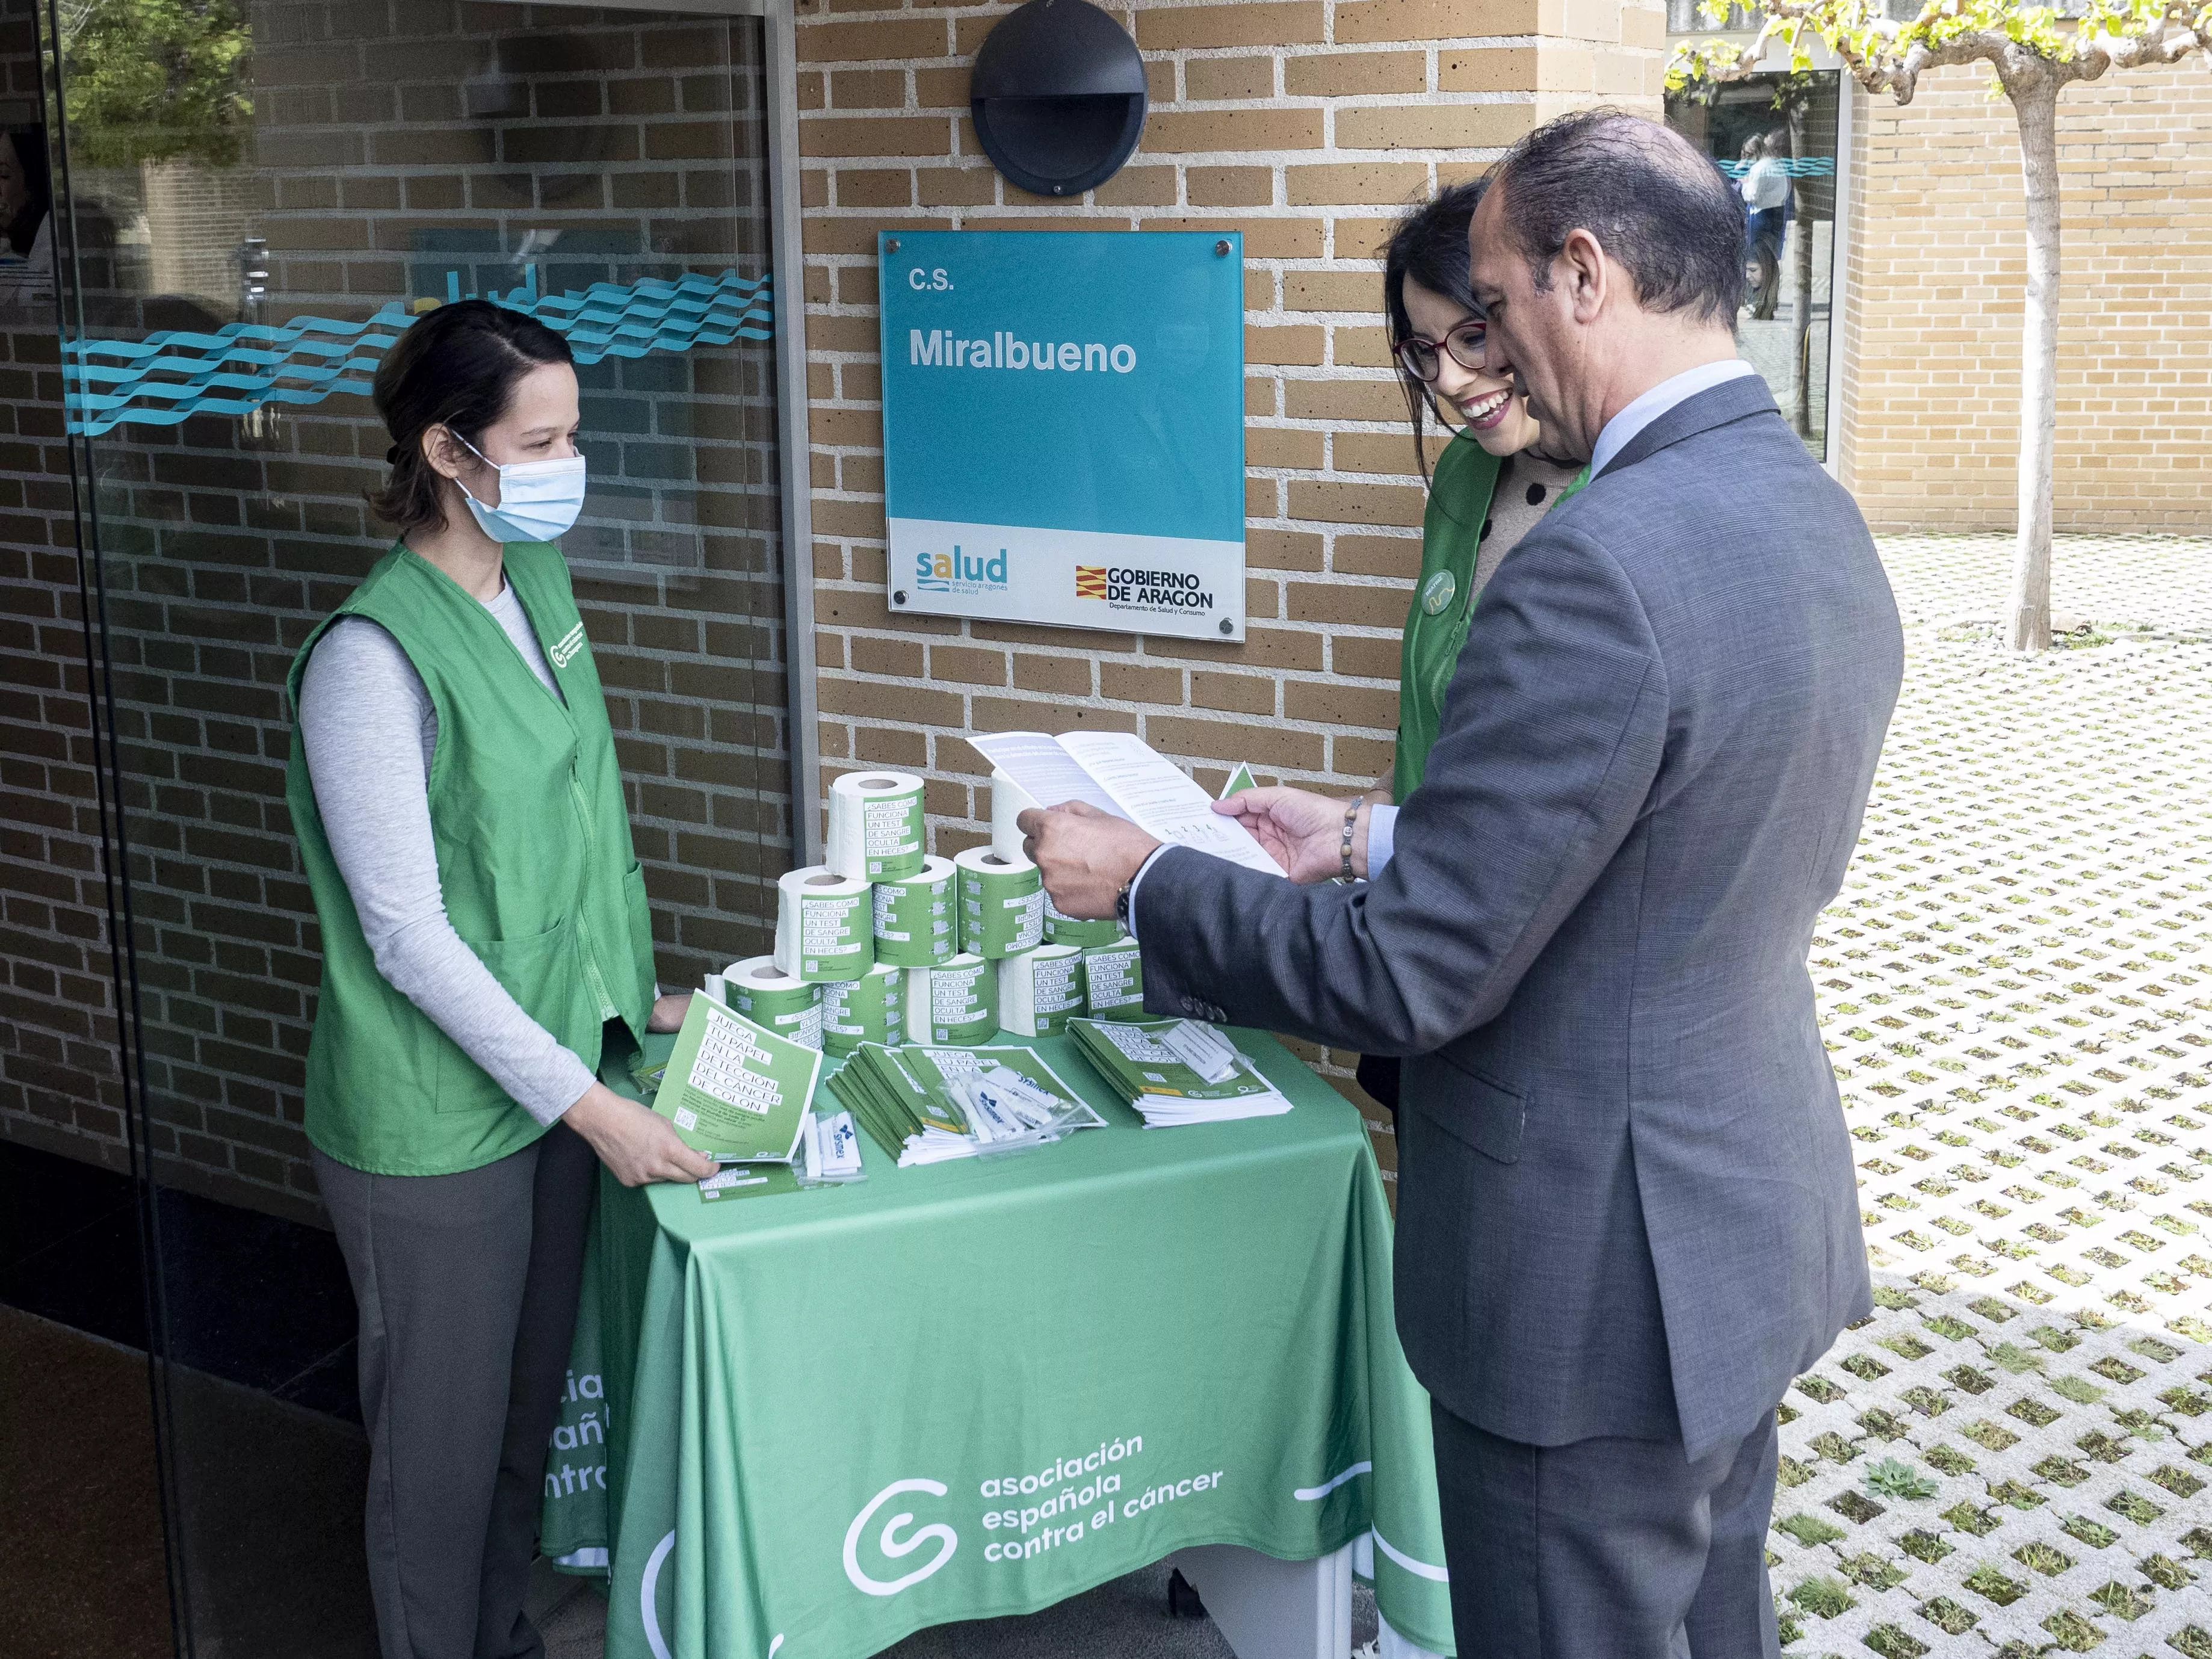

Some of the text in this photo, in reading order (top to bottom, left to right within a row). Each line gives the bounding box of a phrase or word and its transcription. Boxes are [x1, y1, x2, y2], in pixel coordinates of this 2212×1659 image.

[909, 268, 954, 291] C.S.
[910, 329, 1136, 373] Miralbueno
[916, 545, 1007, 584] salud
[1108, 567, 1200, 590] GOBIERNO
[1108, 585, 1213, 609] DE ARAGON
[1109, 602, 1148, 611] Departamento
[1179, 608, 1205, 616] Consumo
[867, 802, 896, 811] ¿SABES
[868, 810, 907, 819] FUNCIONA
[880, 827, 910, 836] SANGRE
[882, 846, 909, 855] HECES?
[1025, 919, 1037, 929] TEST
[1036, 959, 1063, 969] ¿SABES
[1090, 962, 1129, 972] FUNCIONA
[1036, 966, 1074, 977] FUNCIONA
[934, 978, 974, 987] FUNCIONA
[1049, 983, 1075, 994] SANGRE
[1103, 978, 1132, 989] SANGRE
[1092, 989, 1120, 999] OCULTA
[824, 996, 838, 1005] TEST
[946, 996, 976, 1005] SANGRE
[1049, 1000, 1074, 1012] HECES?
[1105, 996, 1132, 1007] HECES?
[791, 1008, 814, 1021] HECES?
[947, 1014, 975, 1023] HECES?
[713, 1015, 753, 1042] JUEGA
[789, 1025, 814, 1039] SANGRE
[824, 1022, 848, 1033] HECES?
[711, 1027, 768, 1062] TU PAPEL
[705, 1038, 741, 1064] EN LA
[696, 1063, 720, 1082] DEL
[701, 1050, 776, 1090] DETECCIÓN
[692, 1075, 709, 1090] DE
[712, 1087, 761, 1111] COLON
[834, 1134, 845, 1158] sysmex
[980, 1435, 1143, 1498] asociación
[982, 1474, 1121, 1534] española
[984, 1470, 1223, 1562] contra el cáncer
